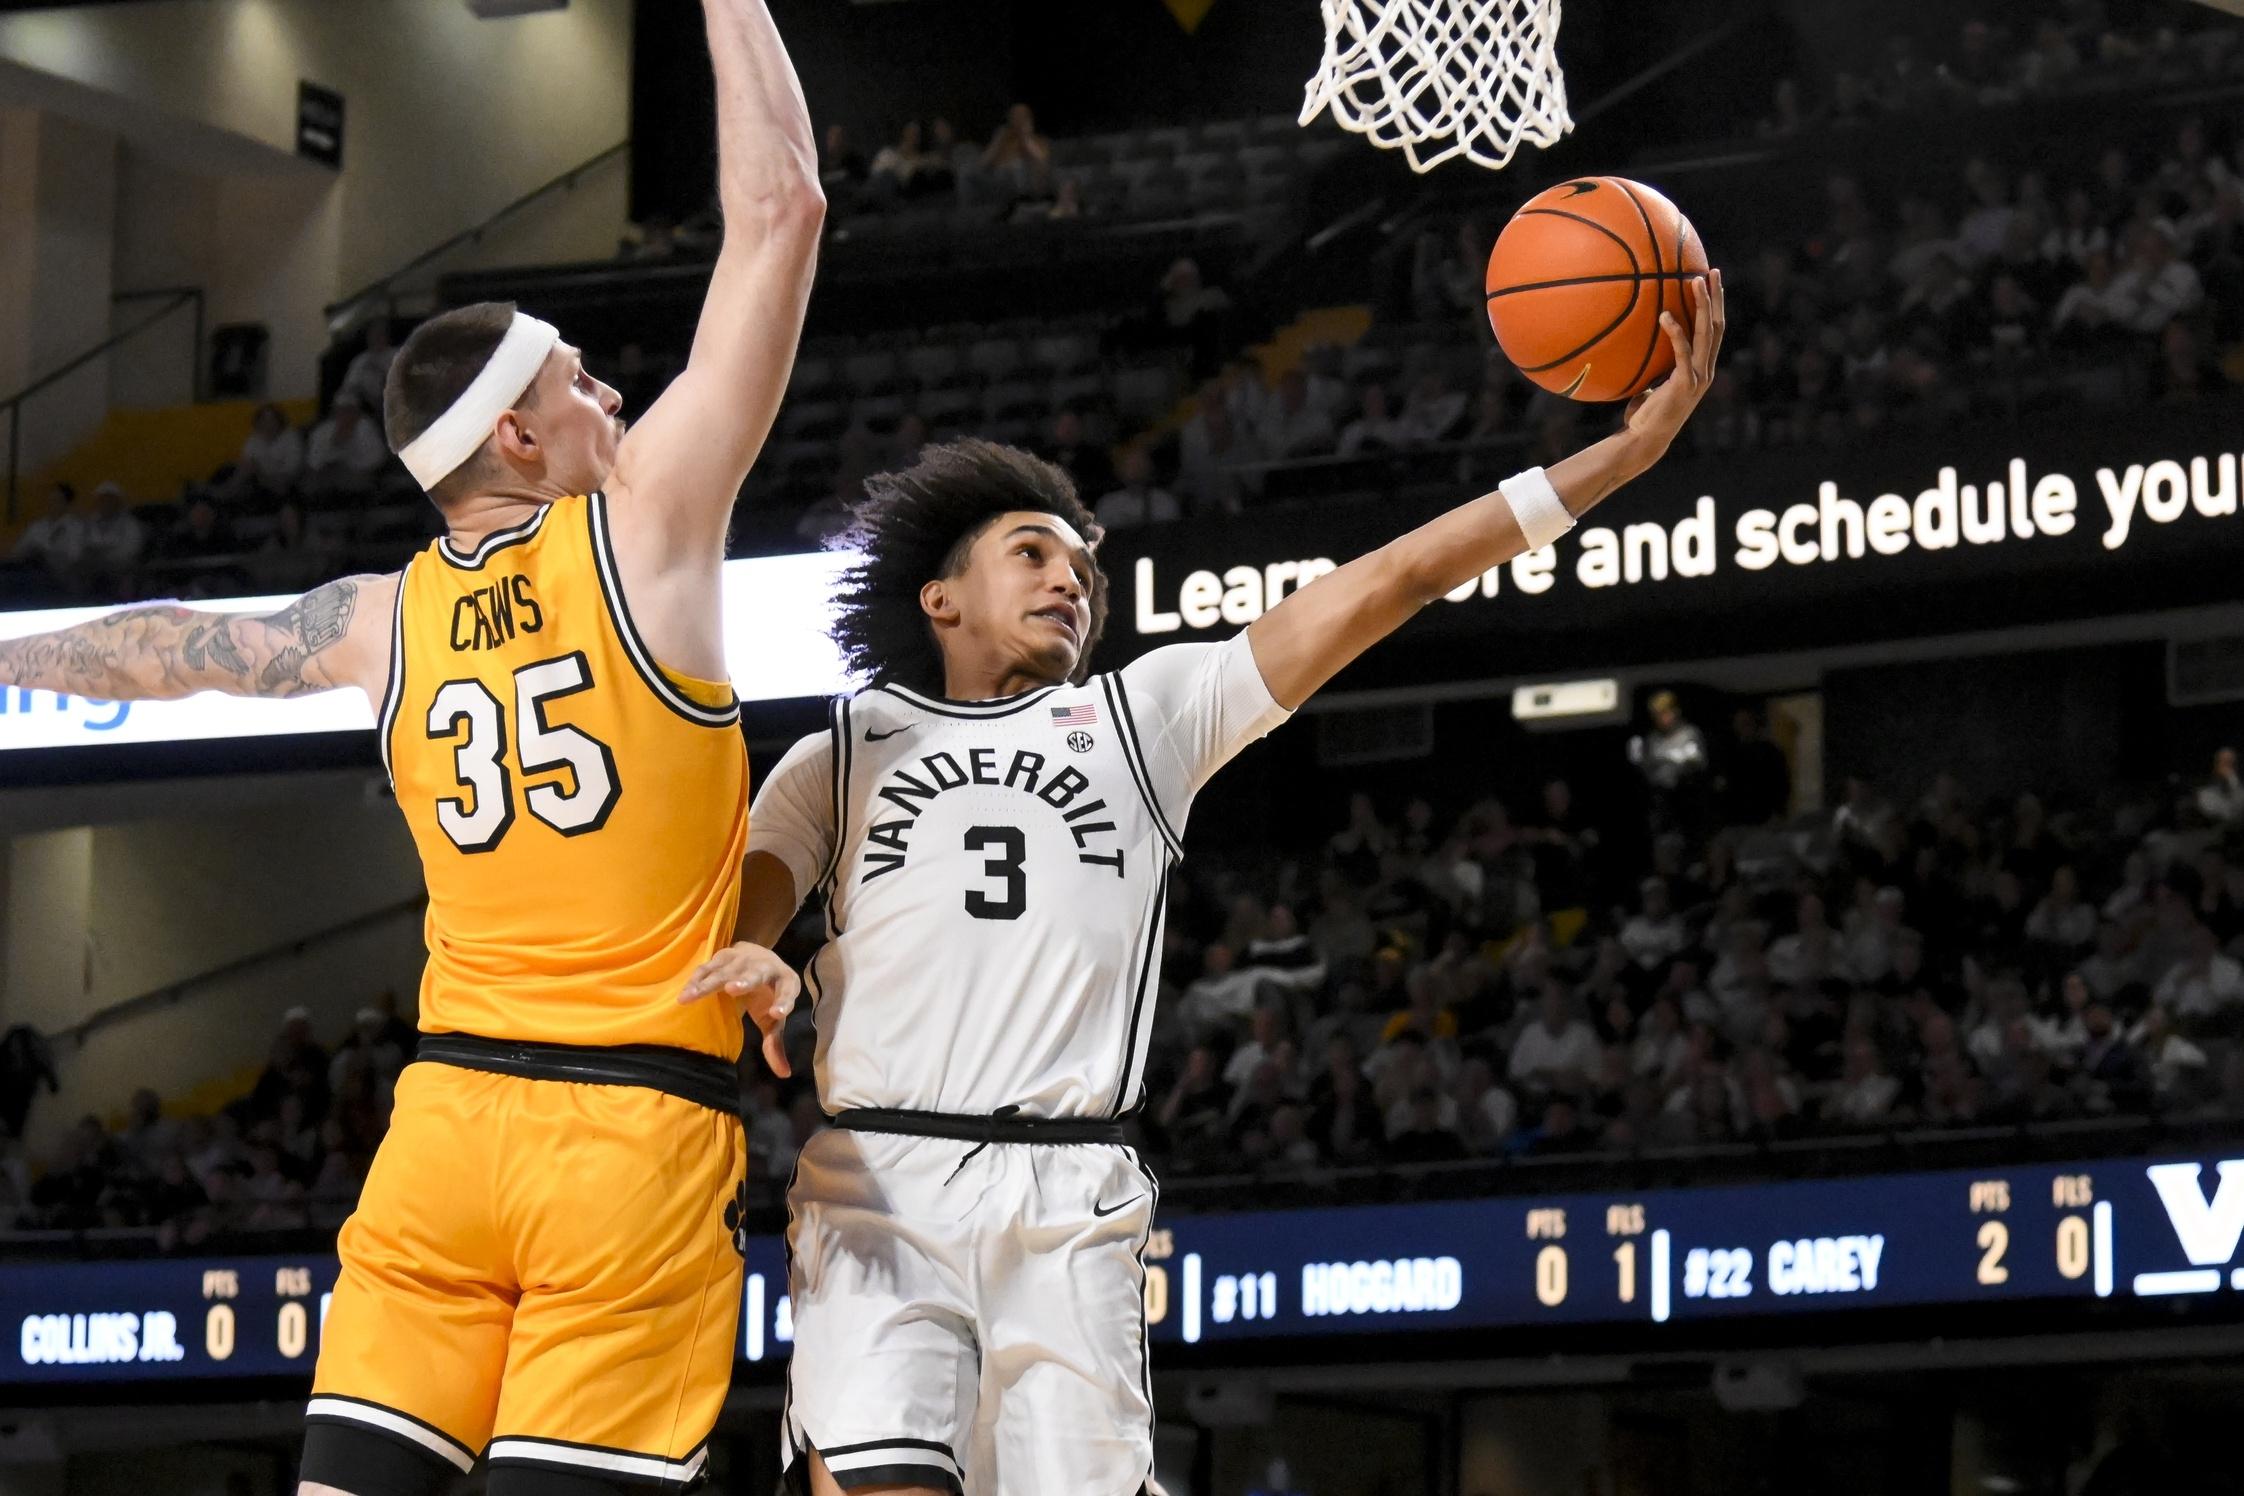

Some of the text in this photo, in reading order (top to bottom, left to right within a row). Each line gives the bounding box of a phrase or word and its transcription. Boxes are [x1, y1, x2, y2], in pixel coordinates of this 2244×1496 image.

[1576, 496, 1716, 588] and
[1734, 457, 2078, 570] schedule
[2095, 452, 2244, 550] you
[426, 650, 623, 854] 35
[1067, 731, 1094, 753] SEC
[861, 748, 1125, 884] VANDERBILT
[964, 825, 1027, 920] 3
[1212, 1241, 1635, 1323] #11 HOGGARD 0 1
[1684, 1215, 2089, 1298] #22 CAREY 2 0
[21, 1301, 307, 1364] COLLINS JR. 0 0
